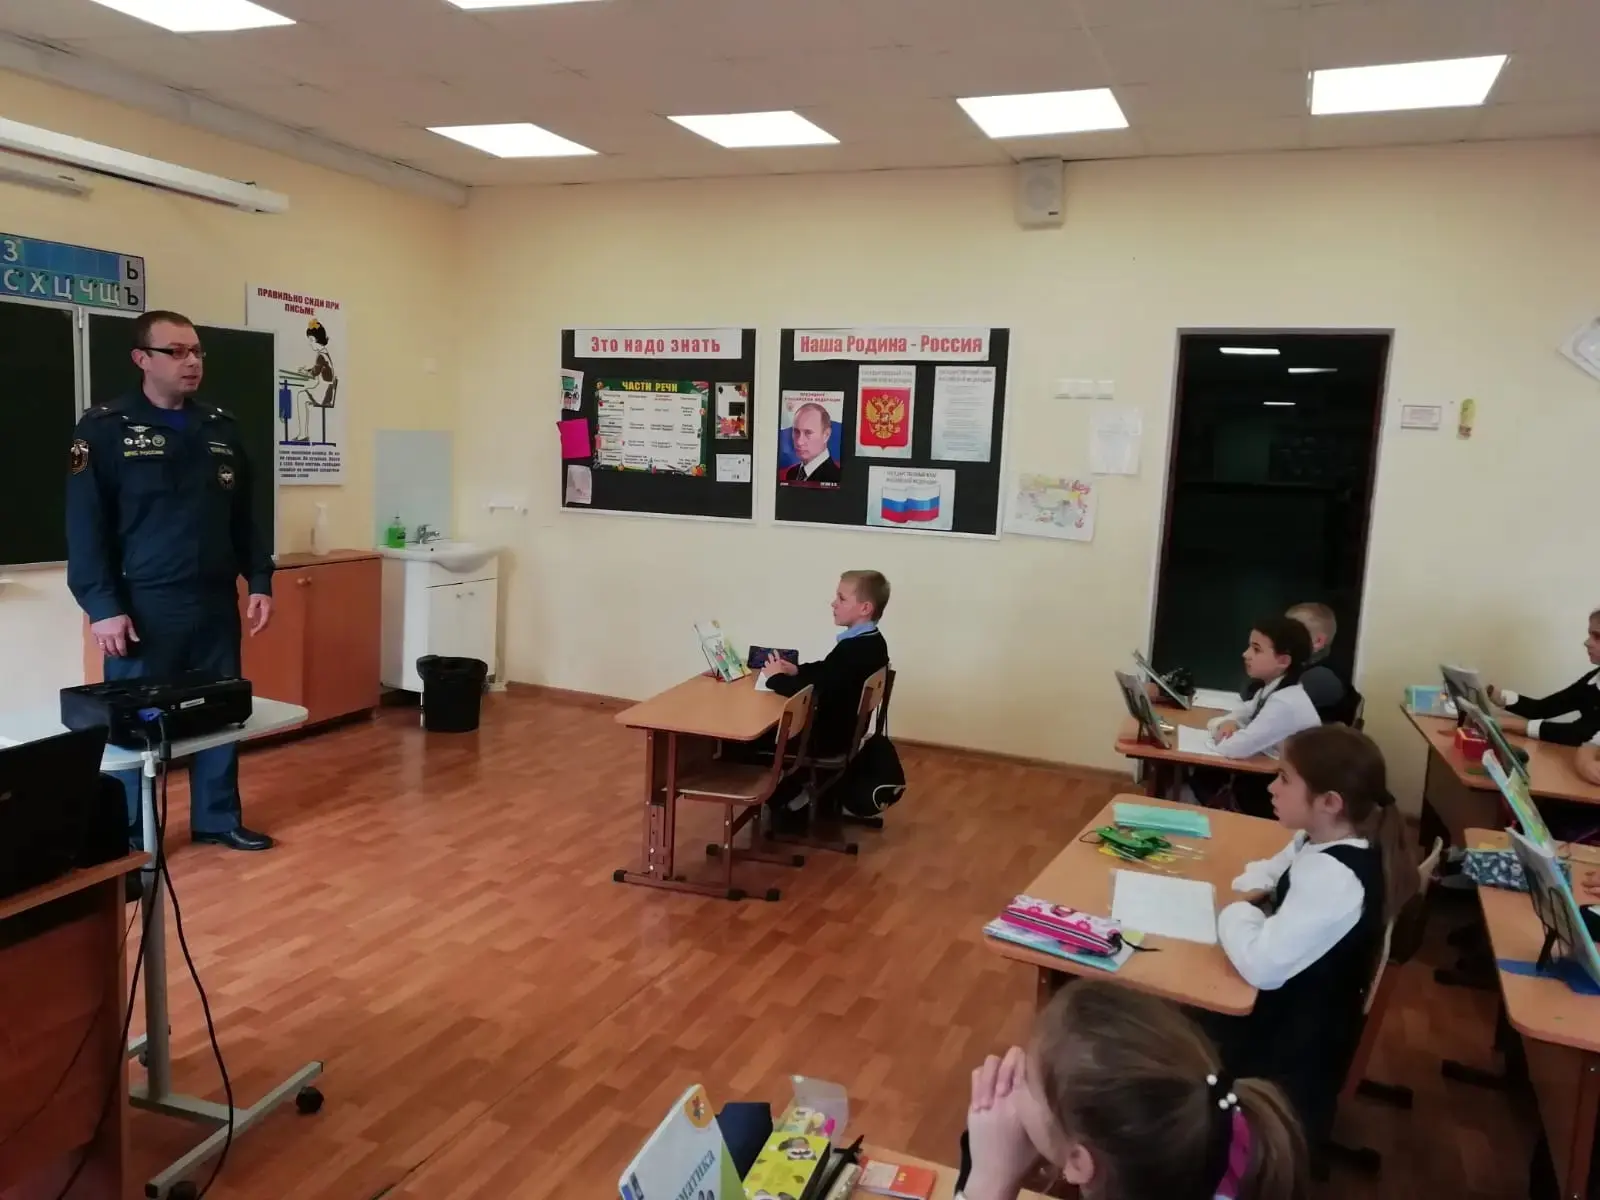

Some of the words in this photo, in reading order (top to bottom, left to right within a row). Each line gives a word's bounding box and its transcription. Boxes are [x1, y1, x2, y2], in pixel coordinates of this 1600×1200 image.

[3, 239, 18, 262] З
[126, 260, 139, 280] Ь
[3, 269, 20, 291] С
[30, 272, 46, 294] Х
[54, 275, 72, 300] Ц
[80, 279, 93, 301] Ч
[100, 282, 120, 307] Щ
[124, 286, 139, 306] Ъ
[257, 287, 303, 304] ПРАВИЛЬНО
[304, 296, 325, 308] СИДИ
[325, 300, 340, 311] ПРИ
[284, 303, 315, 316] ПИСЬМЕ
[591, 335, 619, 353] Это
[624, 337, 665, 356] надо
[671, 338, 721, 353] знать
[800, 335, 843, 353] Наша
[846, 335, 908, 355] Родина
[920, 334, 983, 353] Россия
[621, 380, 652, 392] ЧАСТИ
[655, 381, 678, 393] РЕЧИ
[675, 1149, 716, 1200] матика
